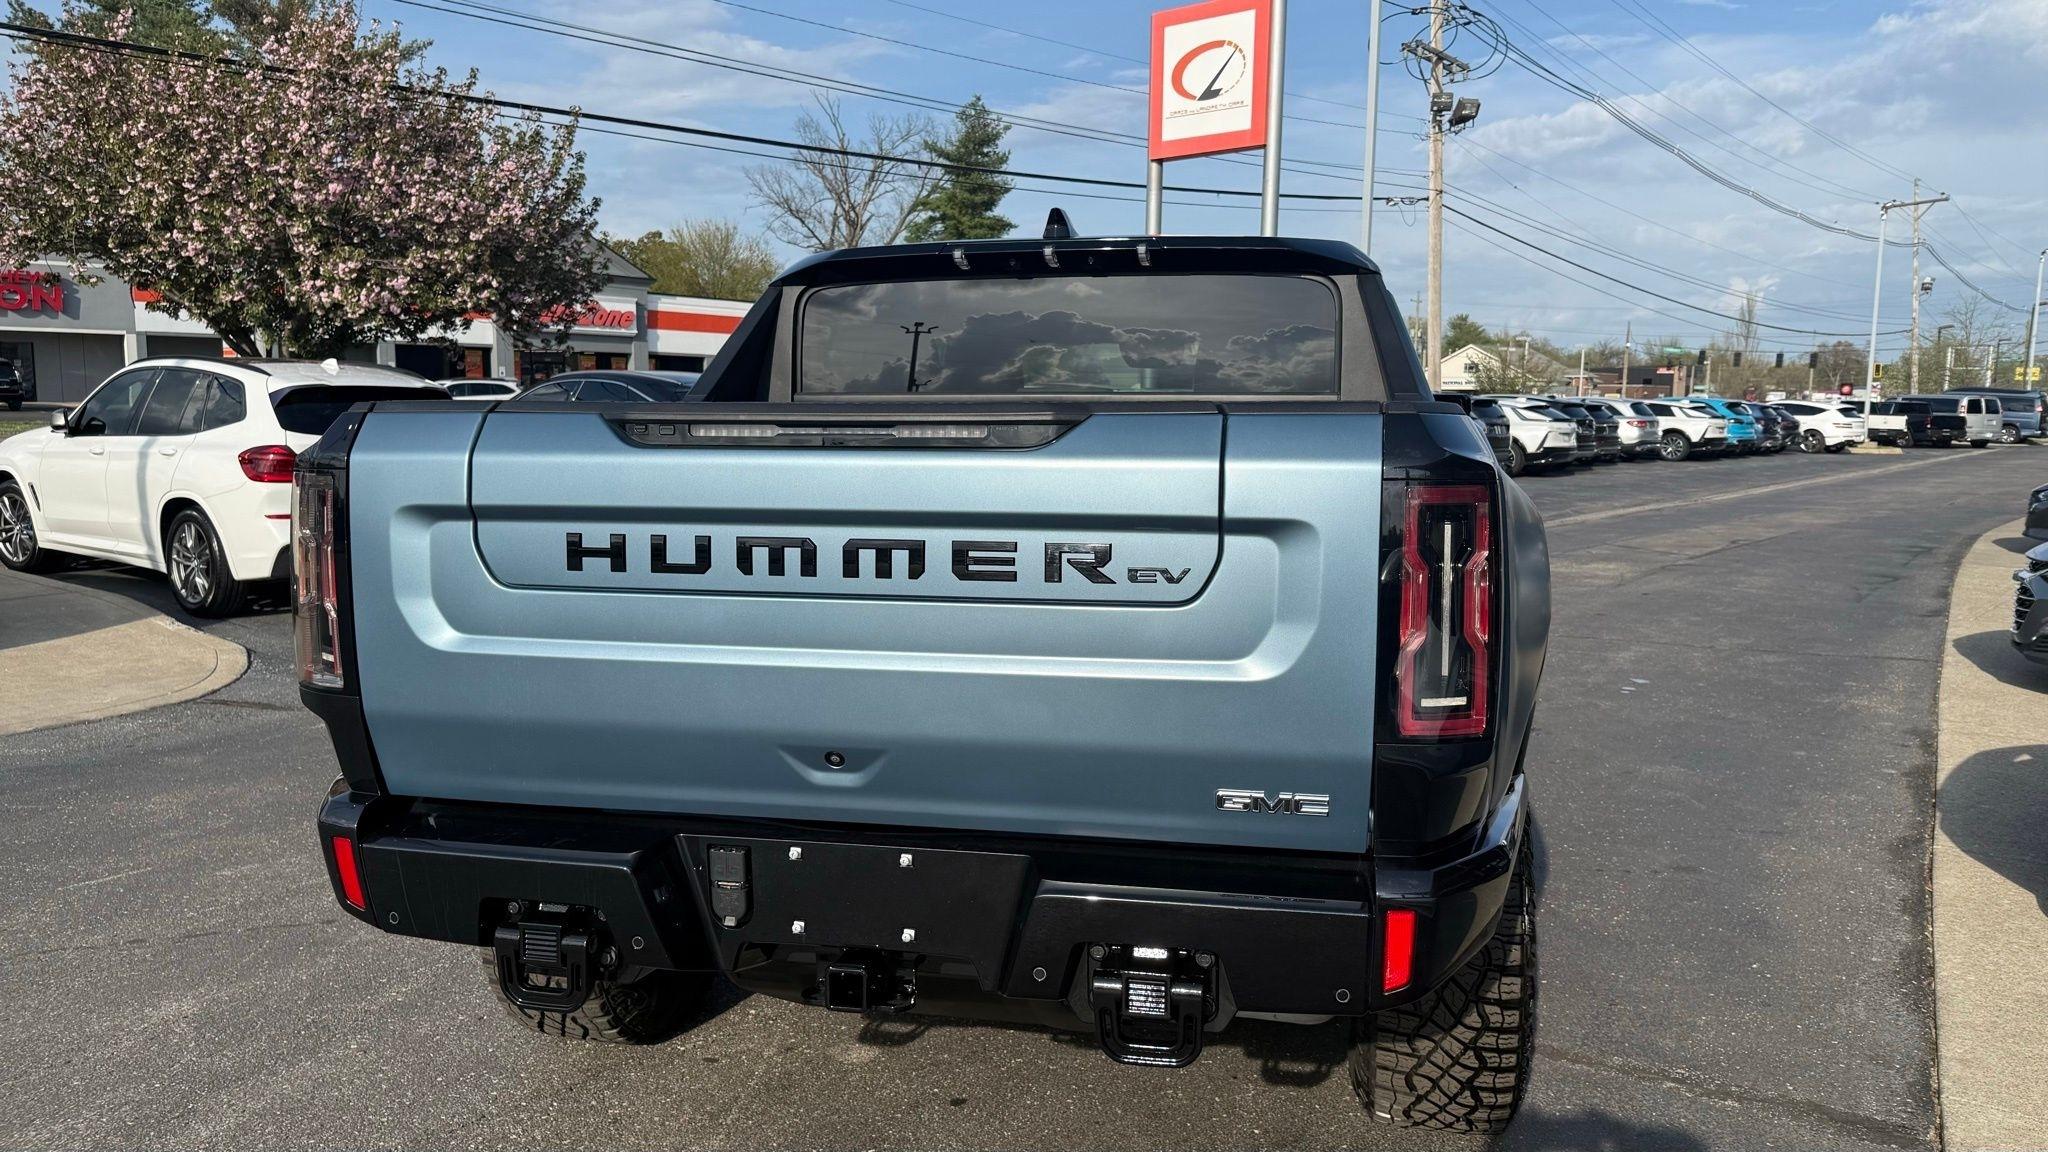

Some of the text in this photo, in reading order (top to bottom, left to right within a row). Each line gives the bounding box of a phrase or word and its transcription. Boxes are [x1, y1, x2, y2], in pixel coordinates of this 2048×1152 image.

[566, 532, 1192, 584] HUMMER EV
[1215, 788, 1330, 817] GMC
